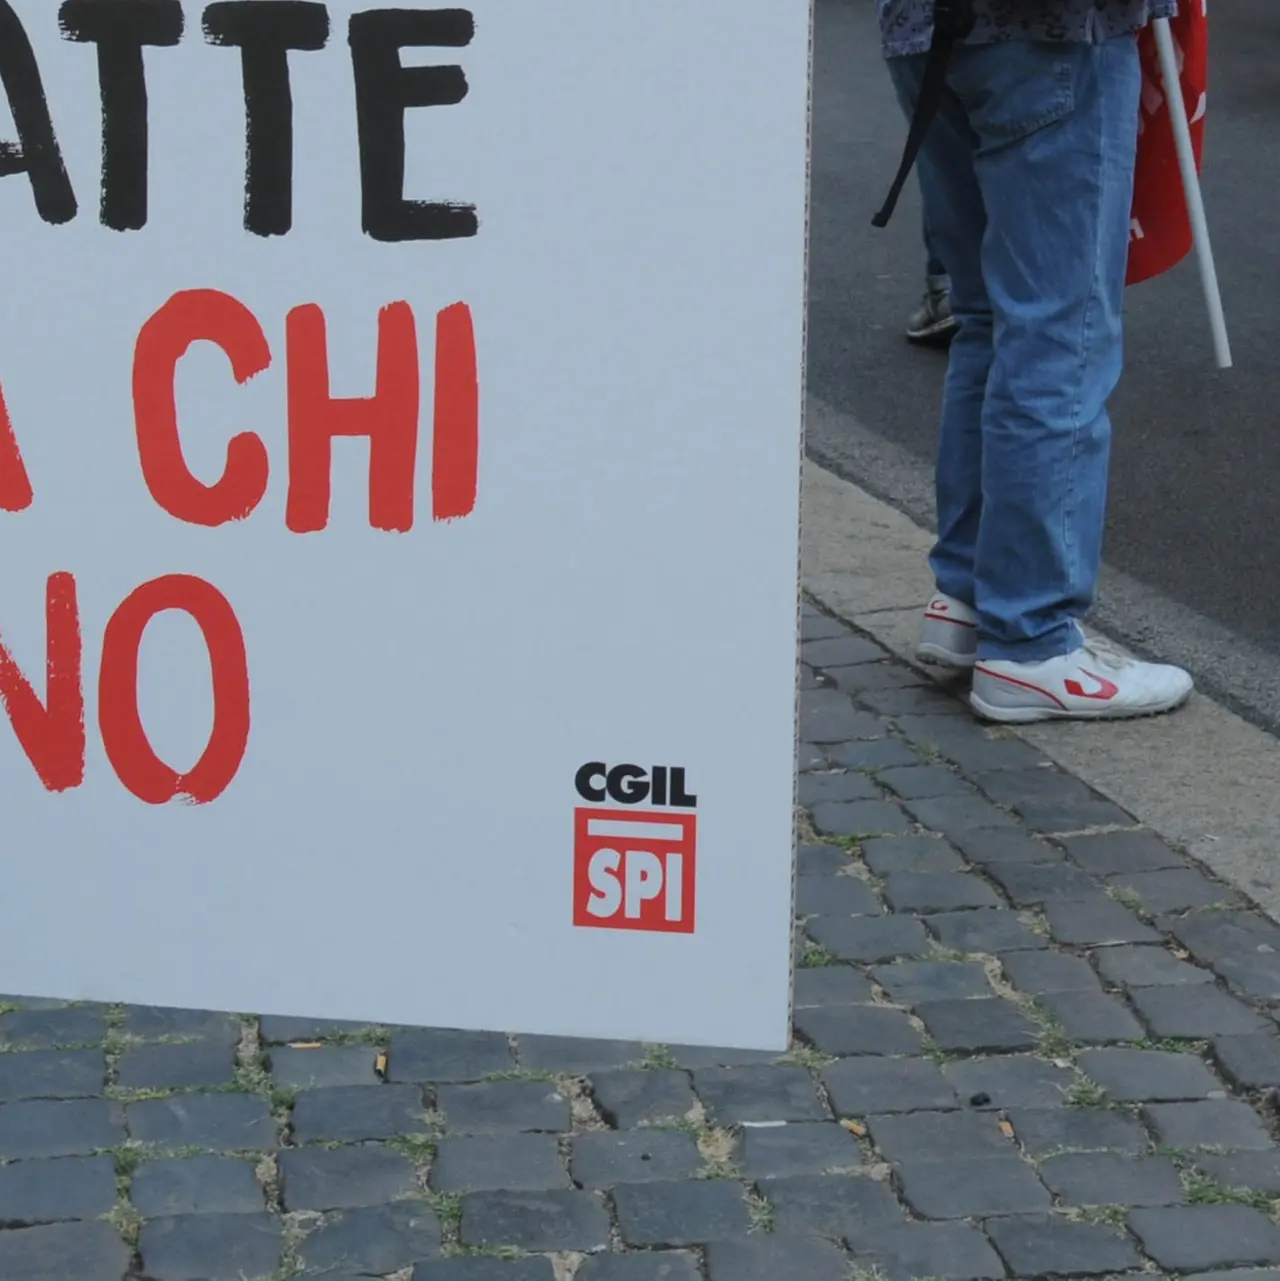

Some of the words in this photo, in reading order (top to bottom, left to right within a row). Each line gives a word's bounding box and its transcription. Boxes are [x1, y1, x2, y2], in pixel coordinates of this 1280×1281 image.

[132, 289, 480, 534] CHI
[575, 761, 697, 808] CGIL
[586, 847, 683, 922] SPI
